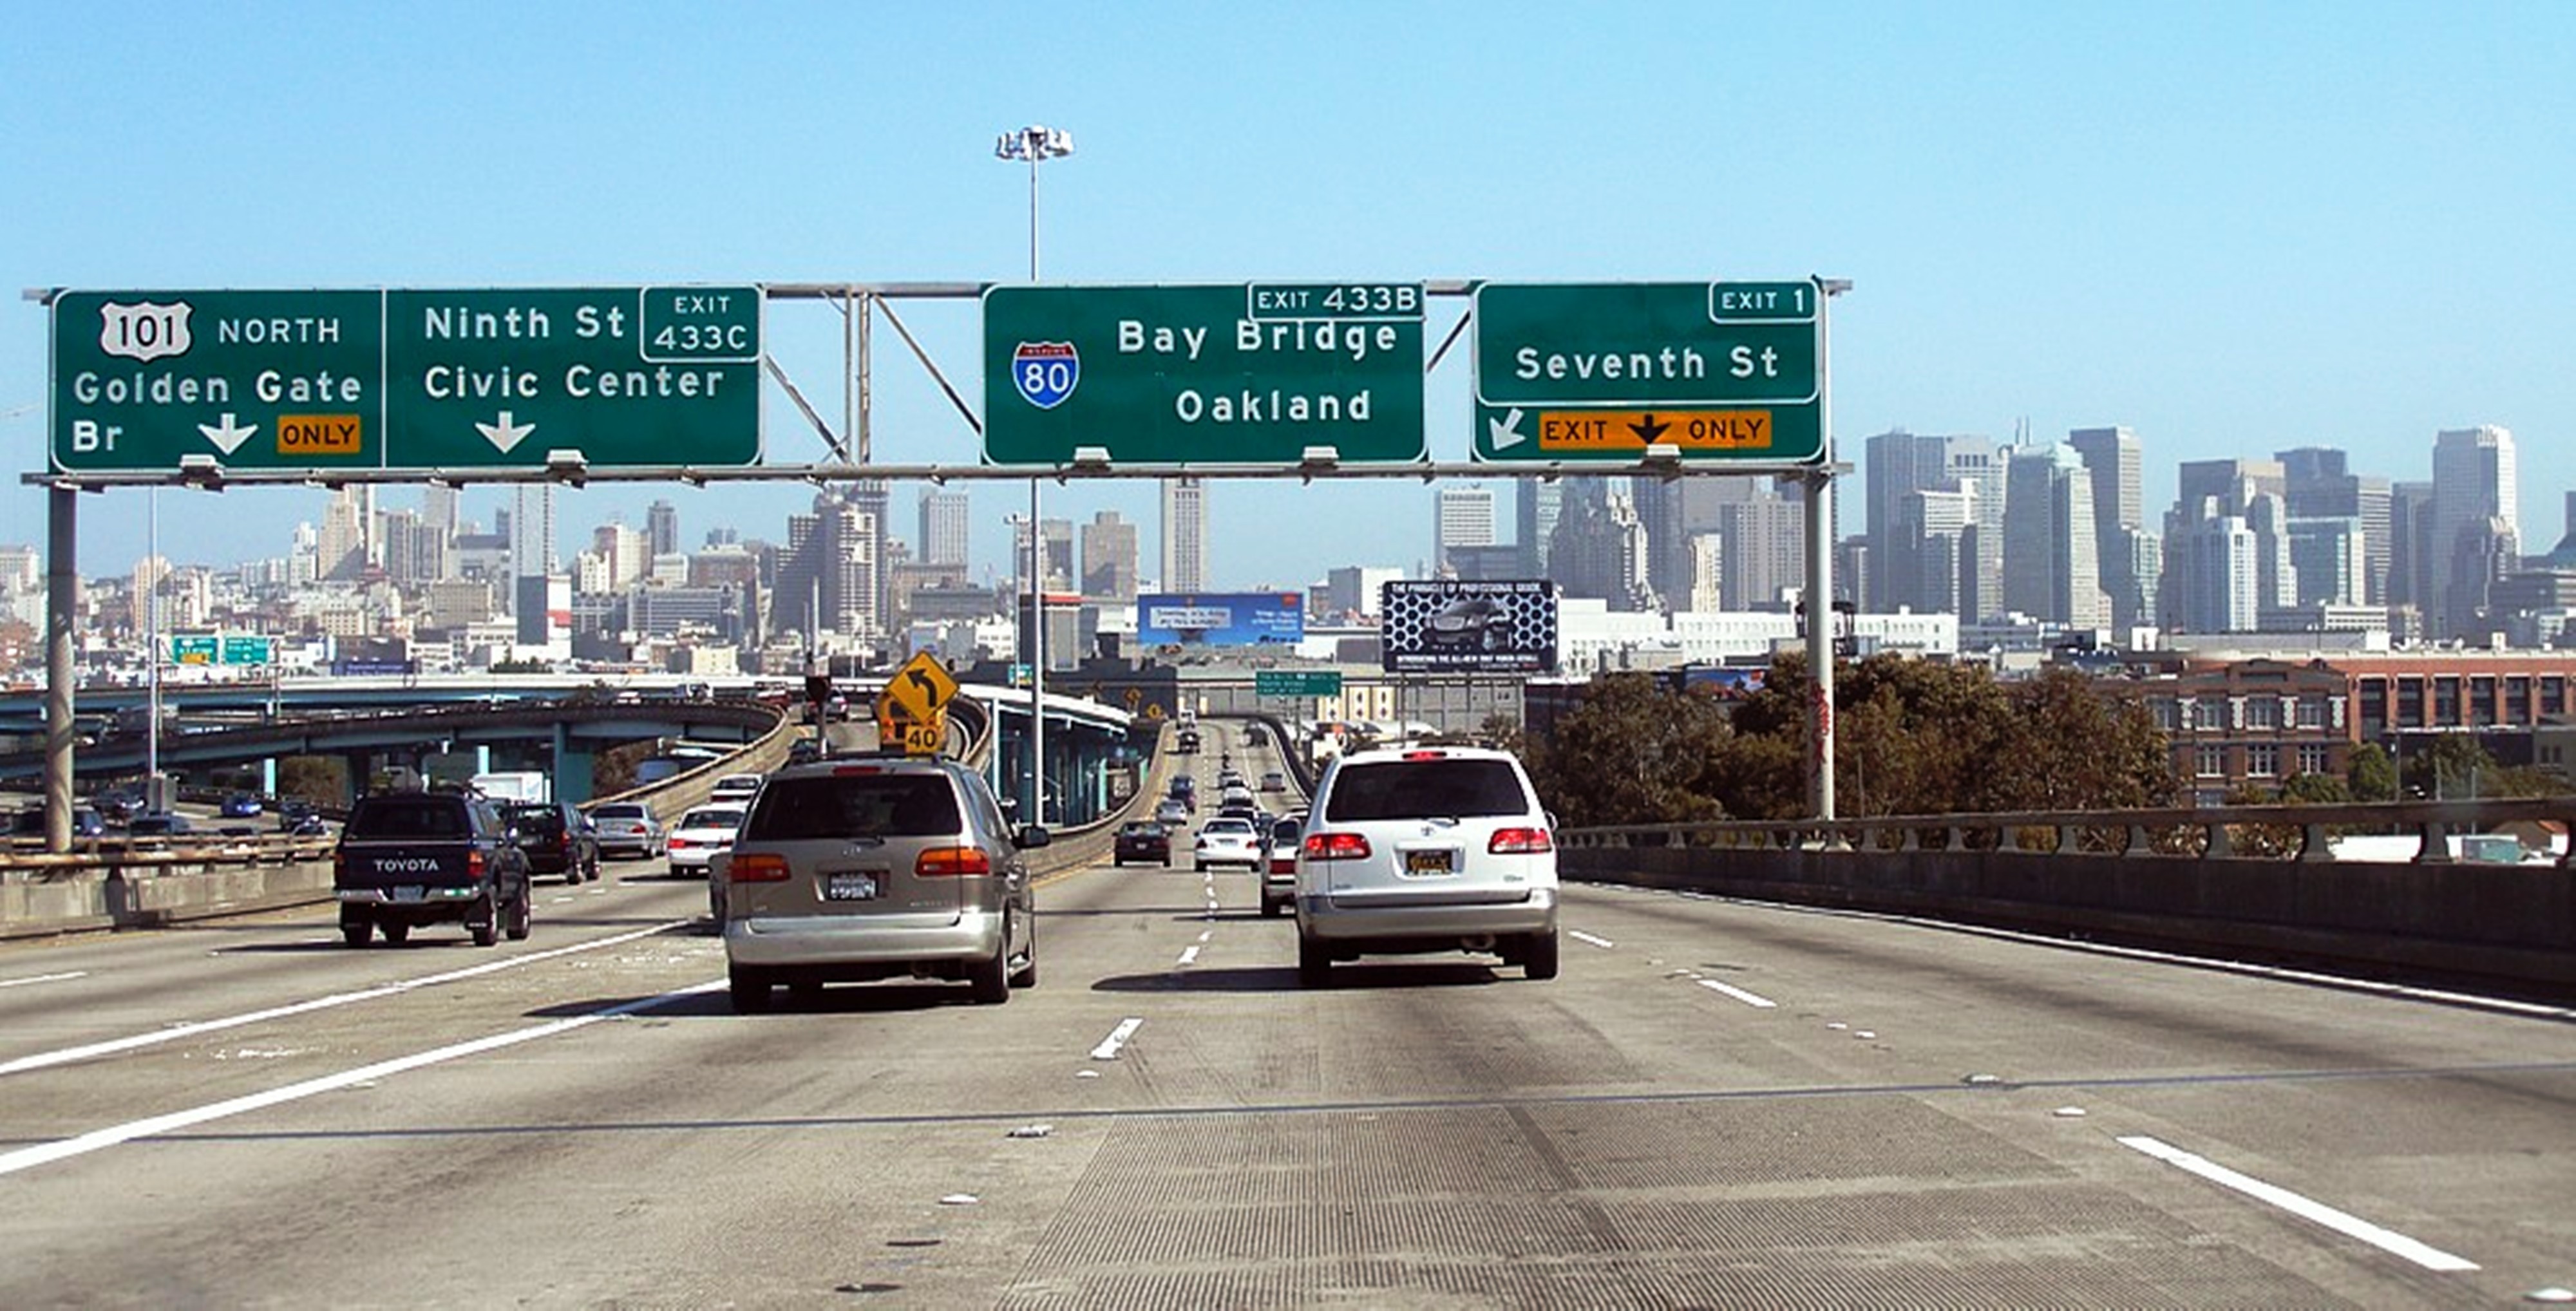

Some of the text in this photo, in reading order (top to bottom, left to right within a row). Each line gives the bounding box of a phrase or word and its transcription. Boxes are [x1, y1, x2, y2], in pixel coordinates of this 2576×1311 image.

[676, 297, 728, 312] EXIT
[1258, 287, 1416, 311] EXIT 433B
[1723, 289, 1803, 312] EXIT 1
[119, 316, 173, 346] 101
[220, 319, 338, 343] NORTH
[426, 306, 623, 338] Ninth St
[655, 325, 745, 350] 433C
[1119, 321, 1397, 361] Bay Bridge
[1517, 346, 1777, 379] Seventh St
[75, 371, 360, 402] Golden Gate
[425, 365, 723, 397] Civic Center
[1024, 362, 1070, 395] 80
[1177, 390, 1368, 421] Oakland
[73, 420, 122, 451] Br
[282, 423, 356, 446] ONLY
[1545, 420, 1764, 441] EXIT ONLY
[907, 729, 938, 749] 40
[374, 858, 440, 872] TOYOTA
